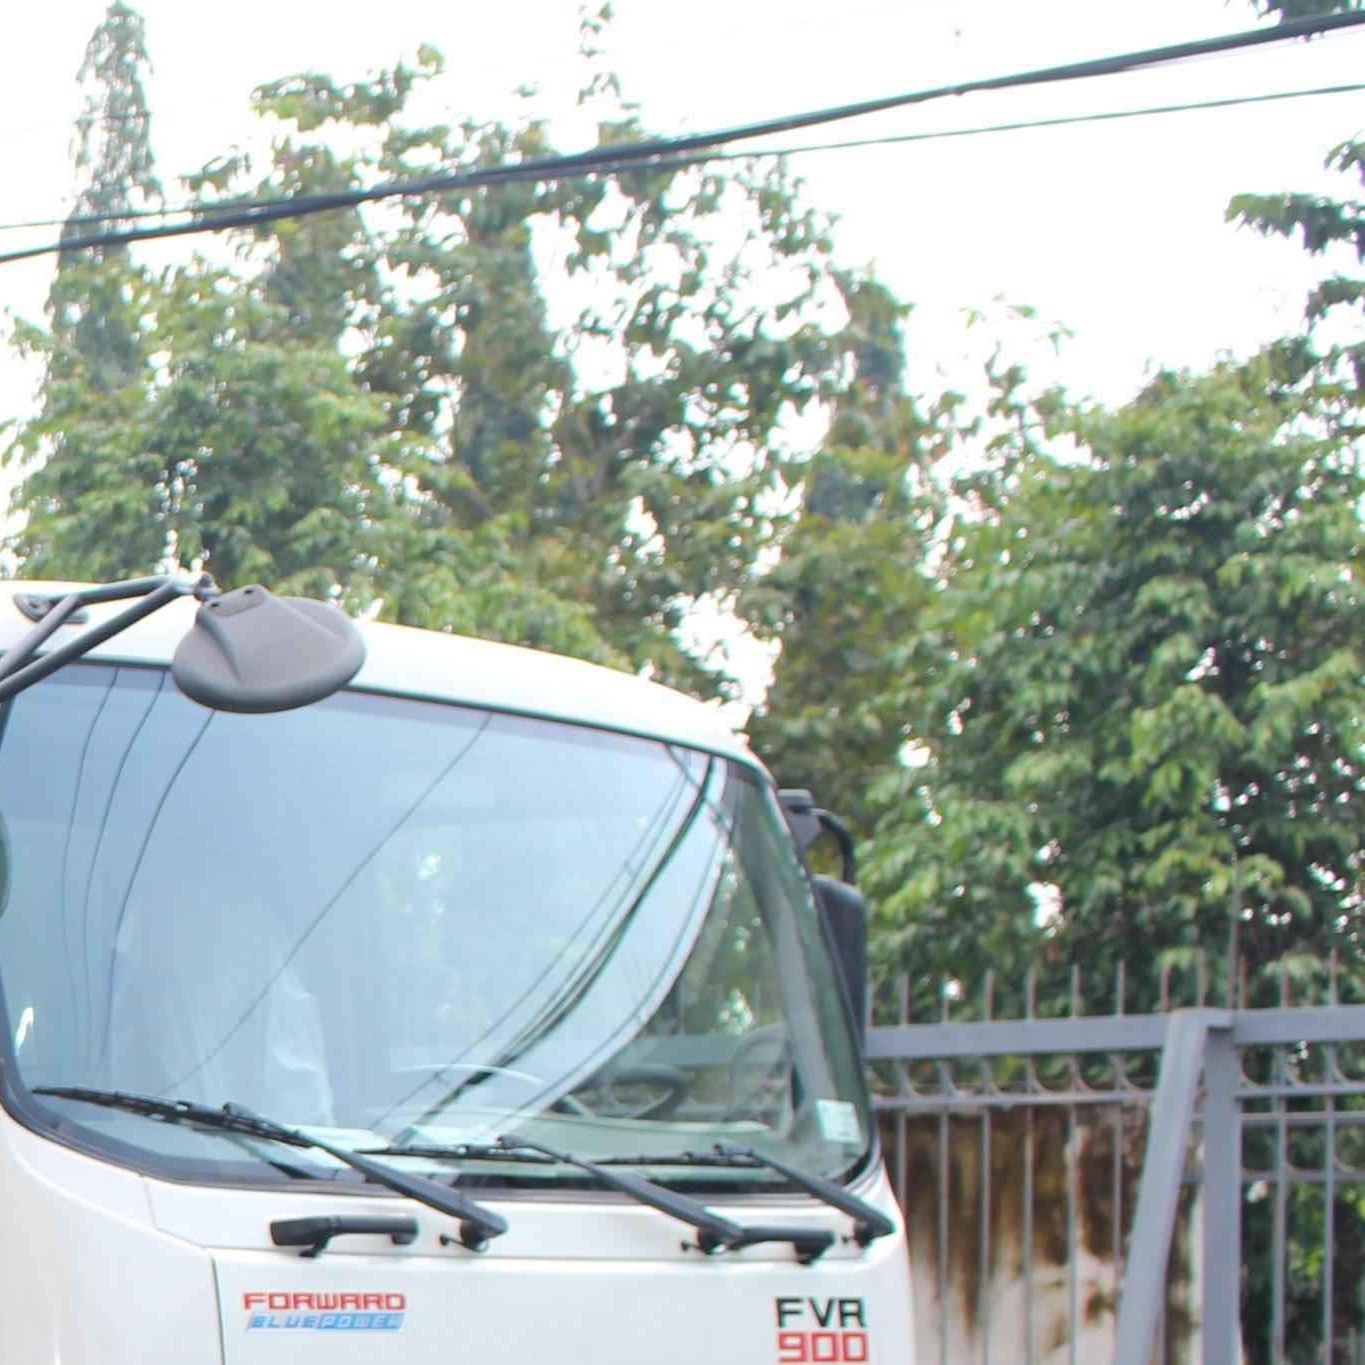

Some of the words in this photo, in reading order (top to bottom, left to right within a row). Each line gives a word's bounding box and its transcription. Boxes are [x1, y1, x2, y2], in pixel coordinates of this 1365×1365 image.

[244, 1292, 406, 1310] FORWARD
[775, 1297, 867, 1328] FVR
[778, 1332, 869, 1363] 900
